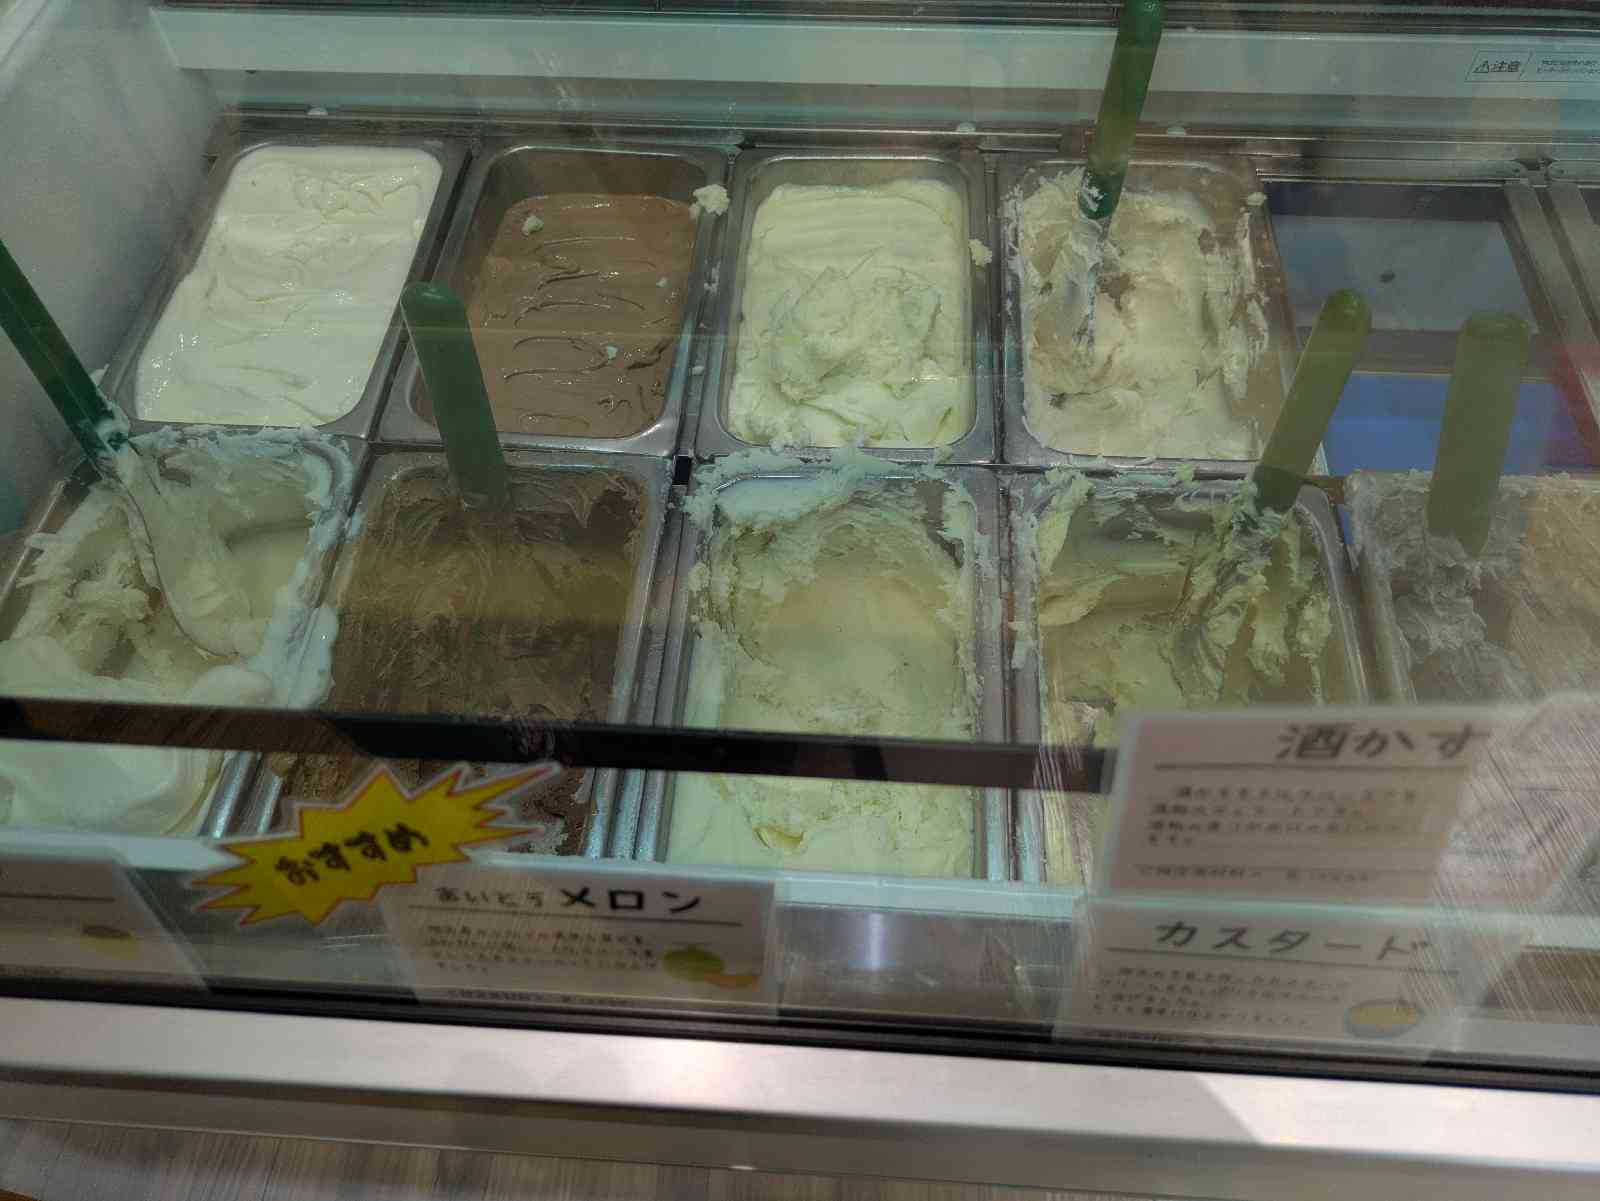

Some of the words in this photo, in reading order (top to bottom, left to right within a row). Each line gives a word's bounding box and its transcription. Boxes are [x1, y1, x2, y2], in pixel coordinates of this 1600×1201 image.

[1275, 721, 1491, 760] 酒かす
[275, 821, 430, 886] おすすめ
[560, 886, 700, 914] メロン
[1153, 919, 1432, 961] カスタード
